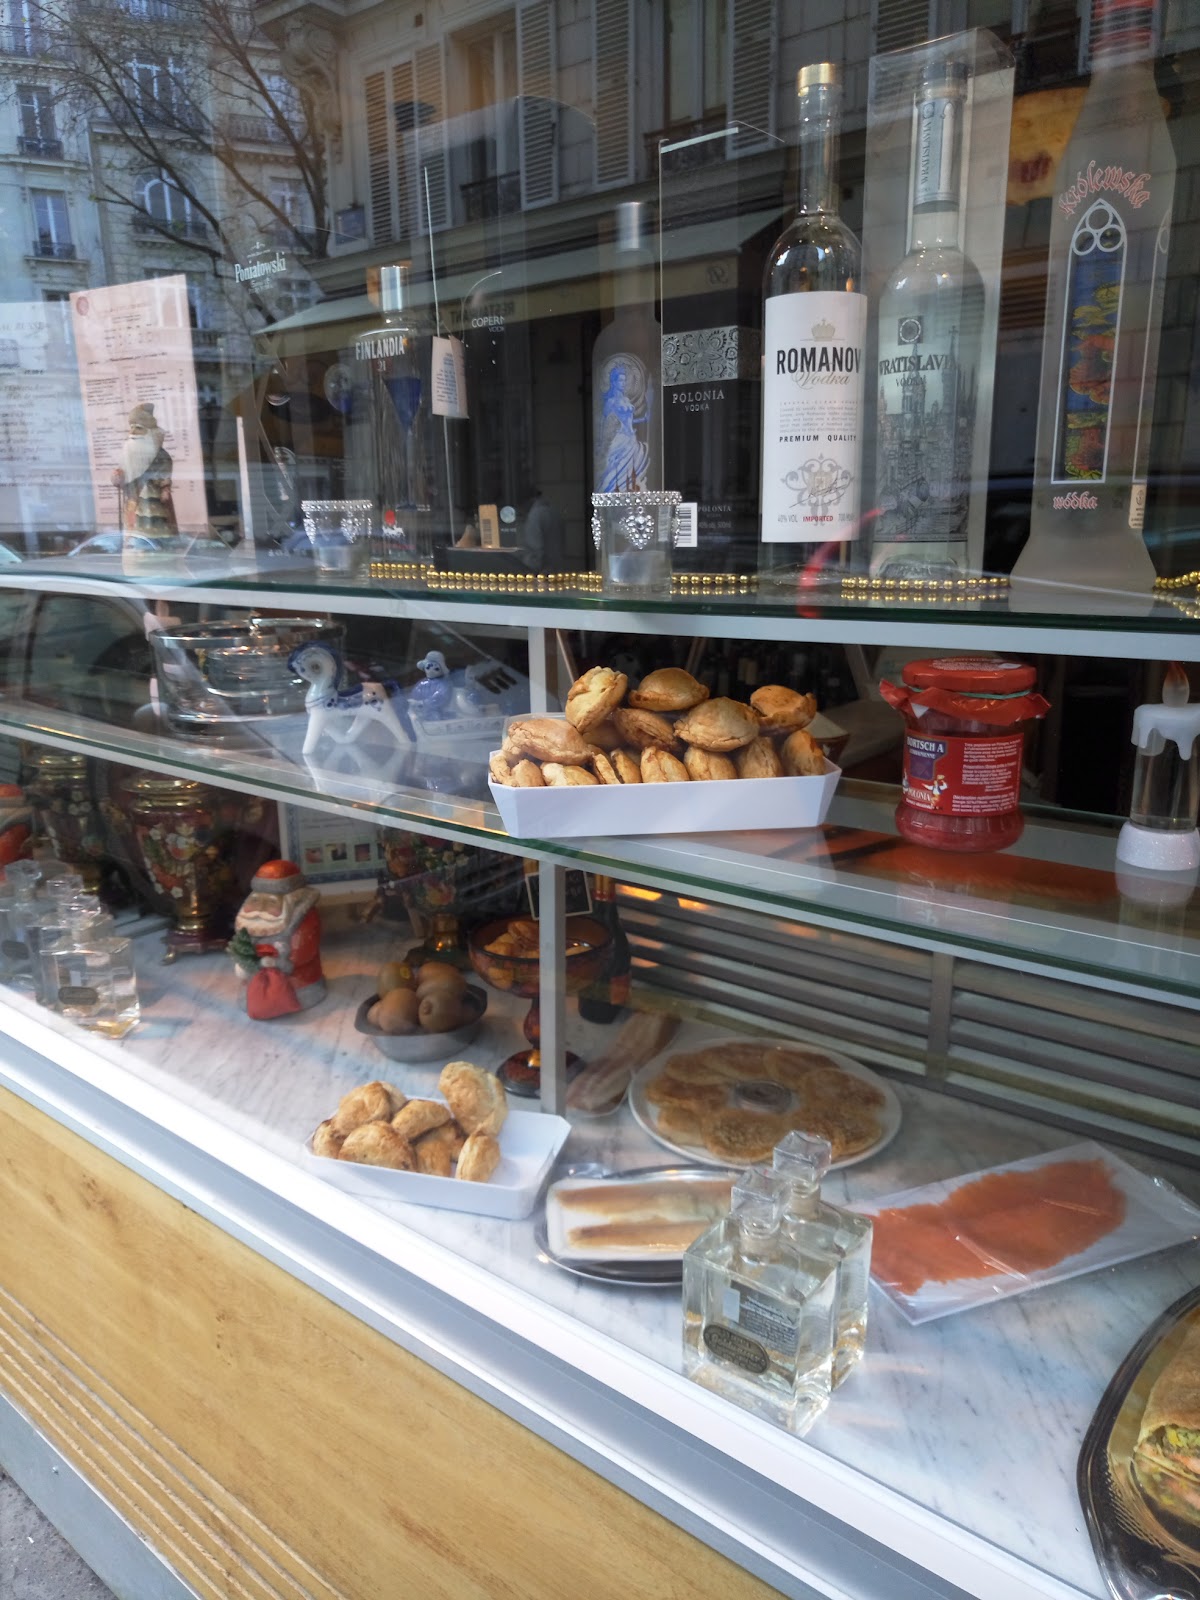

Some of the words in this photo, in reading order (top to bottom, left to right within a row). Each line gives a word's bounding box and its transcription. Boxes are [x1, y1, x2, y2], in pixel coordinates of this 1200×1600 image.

[355, 335, 405, 360] FINLANDIA
[776, 346, 862, 375] ROMANOV
[791, 368, 852, 391] Vodka
[672, 389, 725, 404] POLONIA
[684, 402, 710, 412] VODKA
[779, 434, 819, 443] PREMIUM
[827, 434, 857, 443] QUALITY
[802, 515, 834, 523] IMPORTED
[936, 743, 945, 753] A
